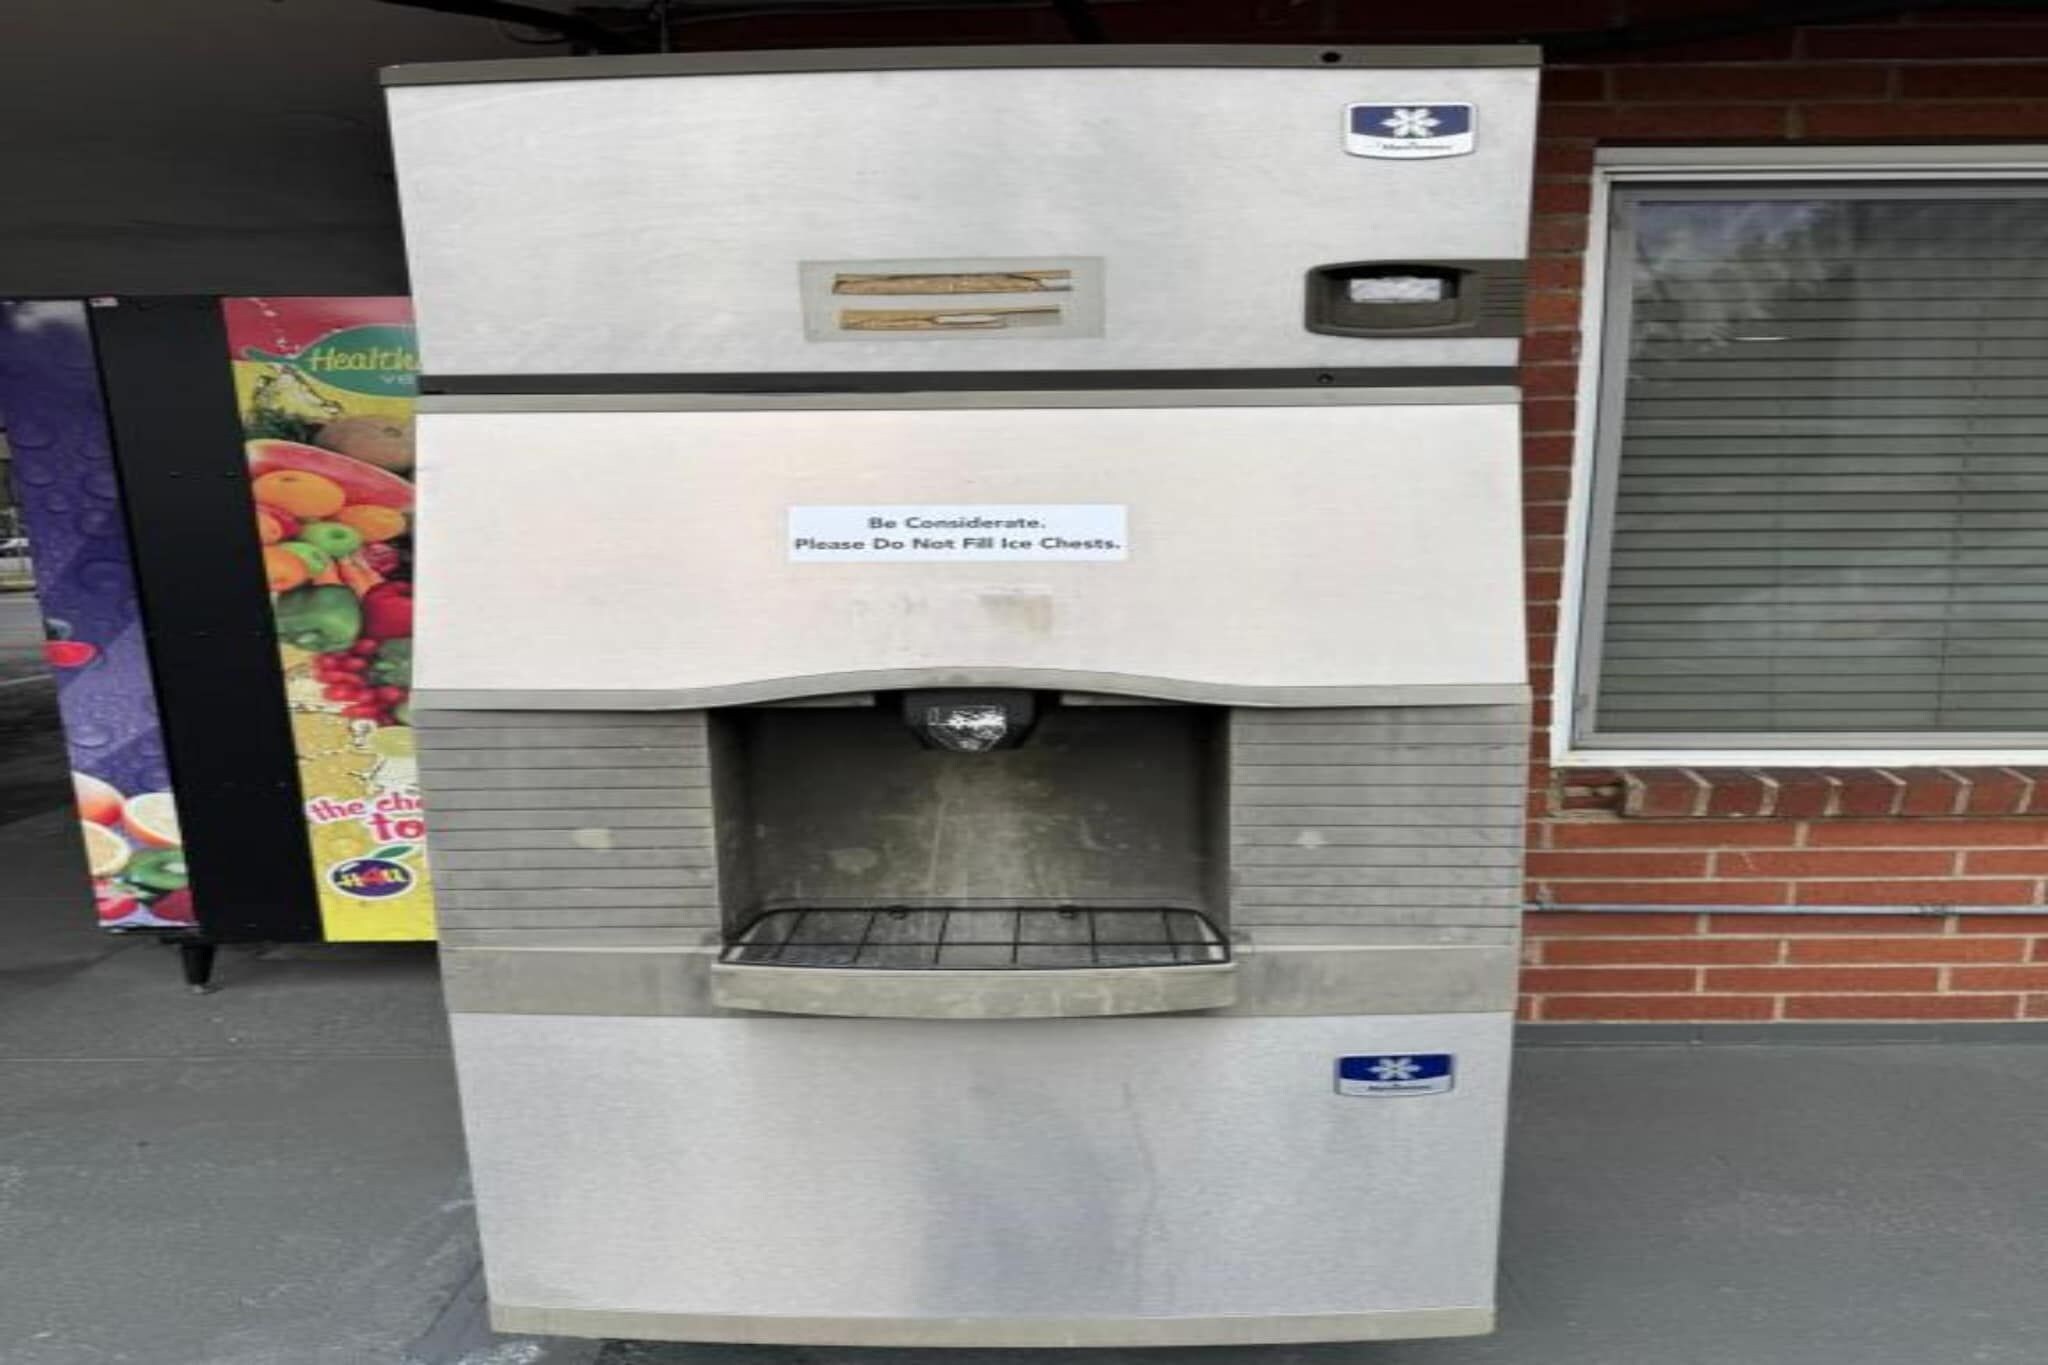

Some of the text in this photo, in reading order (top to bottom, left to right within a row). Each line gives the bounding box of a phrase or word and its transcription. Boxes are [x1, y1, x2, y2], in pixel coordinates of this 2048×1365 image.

[868, 517, 1046, 529] Be Considerate.
[795, 537, 1121, 551] Please Do Not Fill Ice Chests.
[310, 799, 364, 821] the
[369, 812, 425, 841] to
